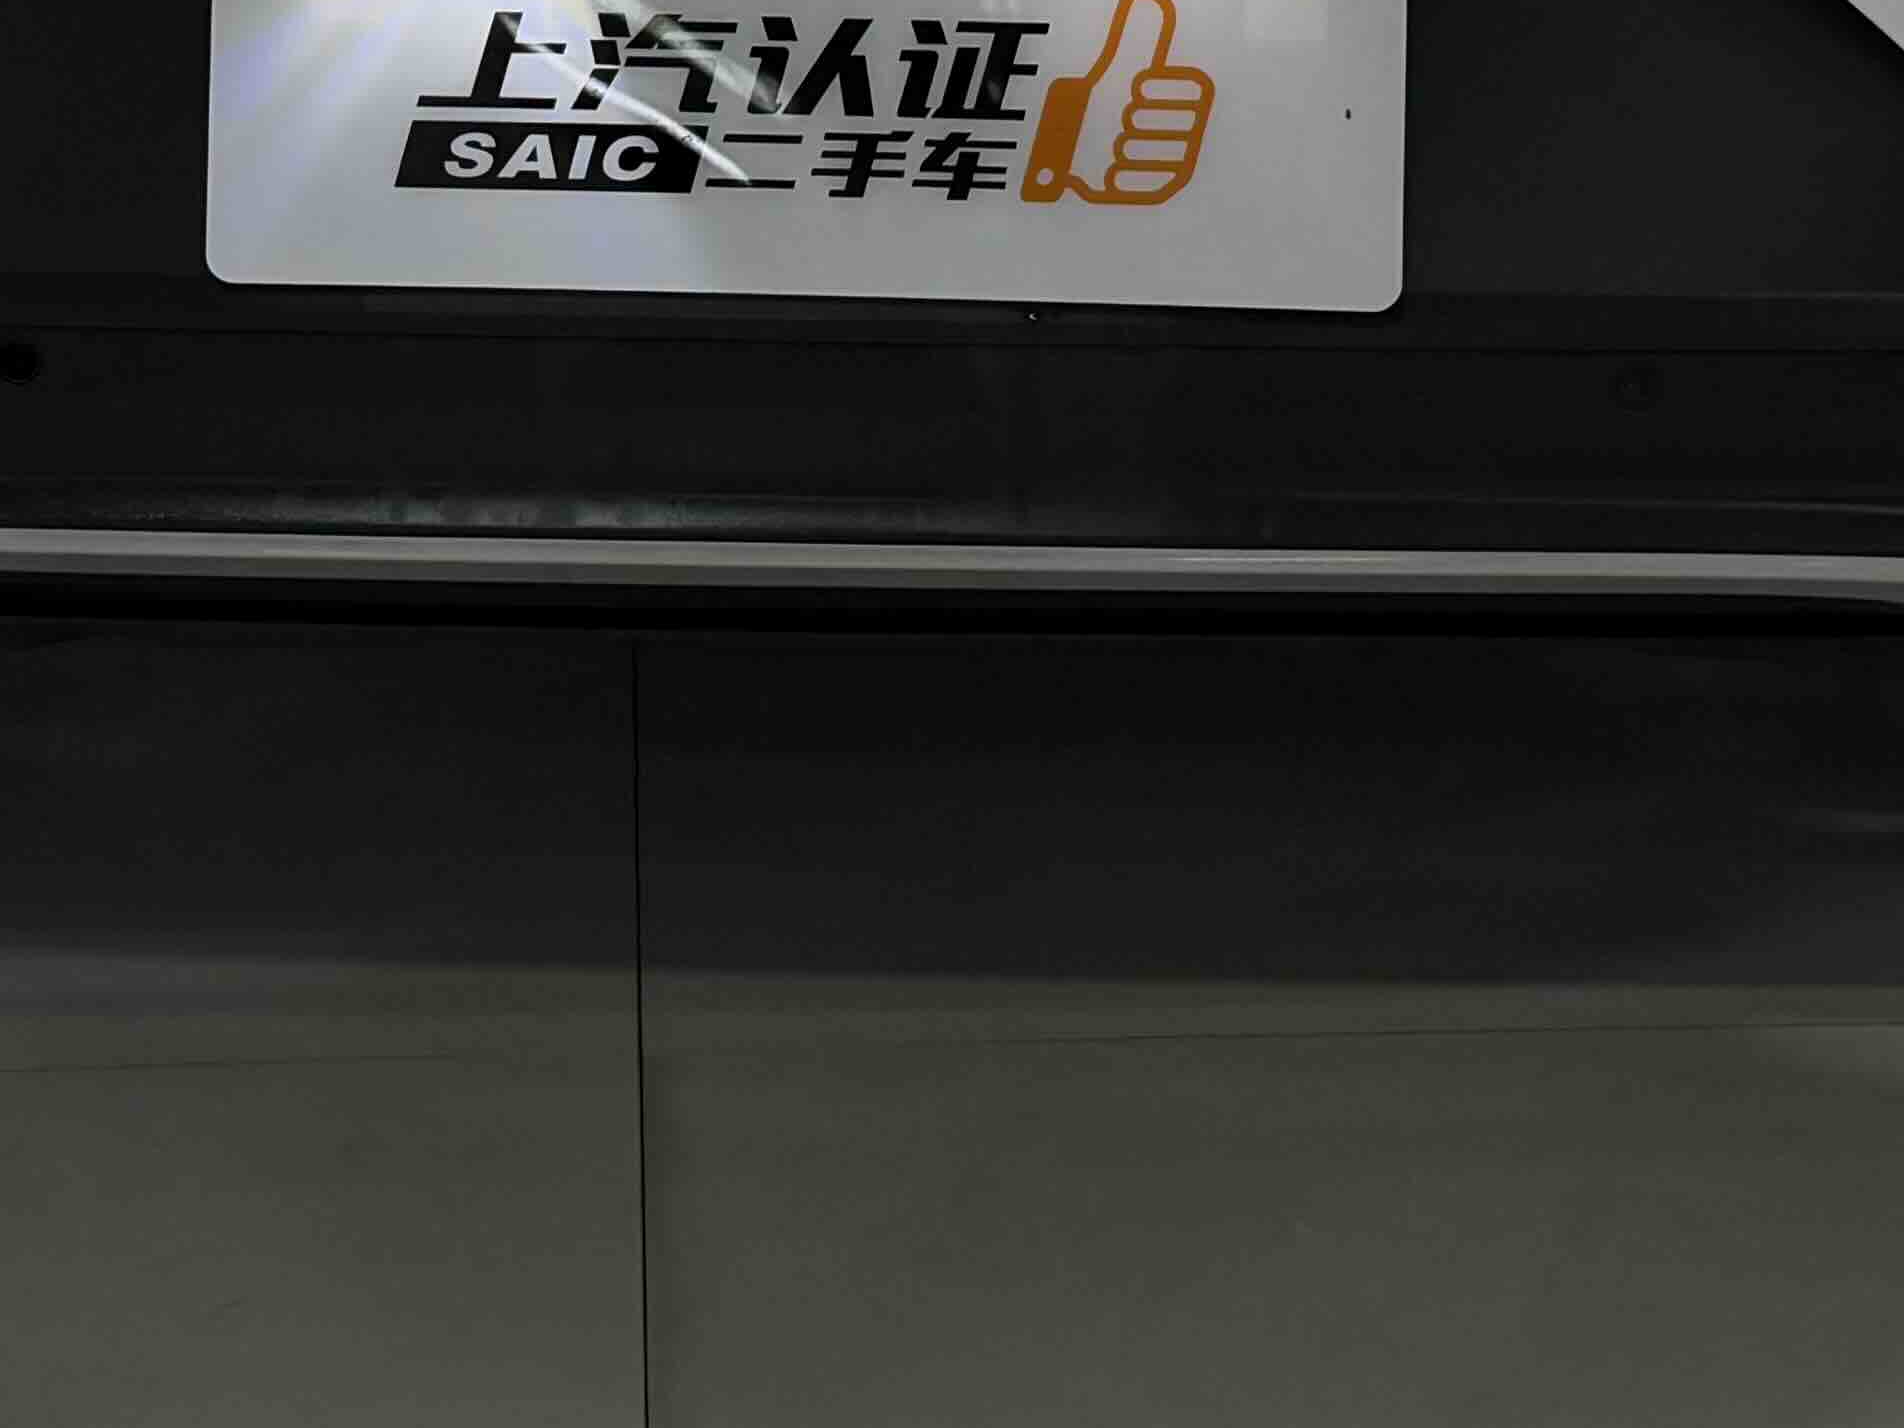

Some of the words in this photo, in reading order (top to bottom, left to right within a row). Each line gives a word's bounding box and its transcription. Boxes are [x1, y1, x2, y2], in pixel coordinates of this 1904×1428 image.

[417, 12, 1051, 121] 上汽认证
[442, 132, 663, 183] SAIC
[703, 130, 1019, 204] 二手车
